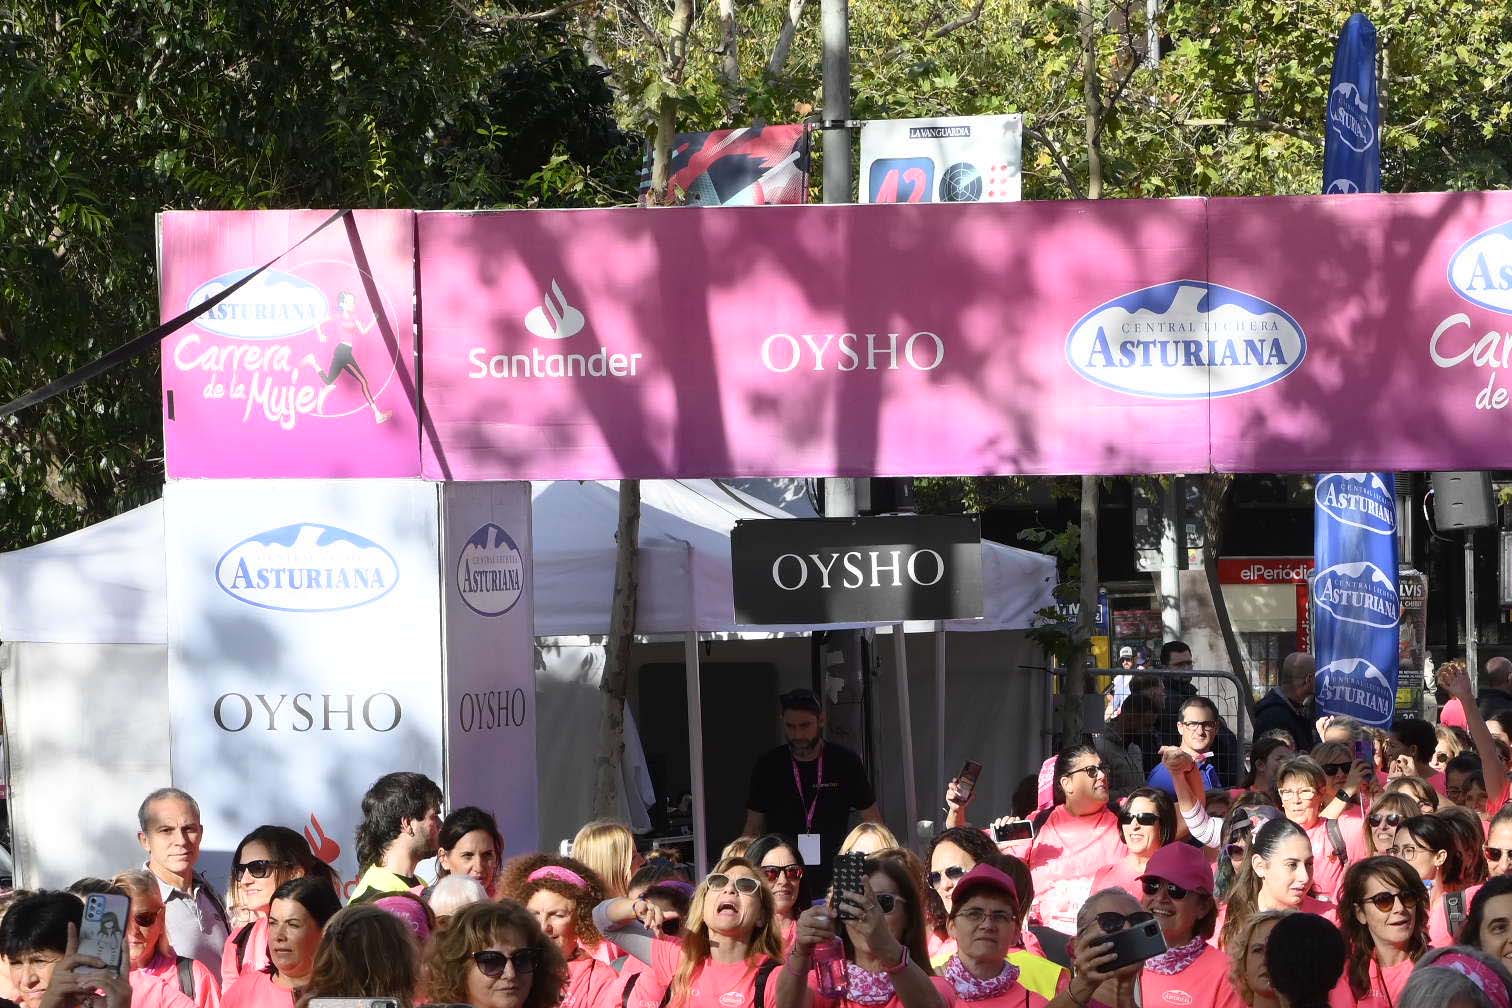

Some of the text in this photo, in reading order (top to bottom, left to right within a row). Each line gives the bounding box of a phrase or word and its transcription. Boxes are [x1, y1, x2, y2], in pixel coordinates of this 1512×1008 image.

[921, 127, 970, 138] VANGUARDIA
[200, 293, 318, 321] ASTURIANA
[1121, 319, 1279, 334] CENTRAL LECHERA
[173, 333, 291, 371] Carrera
[468, 345, 642, 379] Santander
[761, 331, 946, 373] OYSHO
[1086, 325, 1288, 369] ASTURIANA
[203, 368, 337, 429] de la Mujer
[1475, 373, 1510, 411] de
[1324, 482, 1394, 526] ASTURIANA
[230, 556, 385, 590] ASTURIANA
[463, 559, 520, 593] ASTURIANA
[772, 549, 945, 591] OYSHO
[1320, 577, 1397, 620] ASTURIANA
[214, 692, 402, 732] OYSHO
[460, 688, 526, 732] OYSHO
[1319, 674, 1390, 717] ASTURIANA
